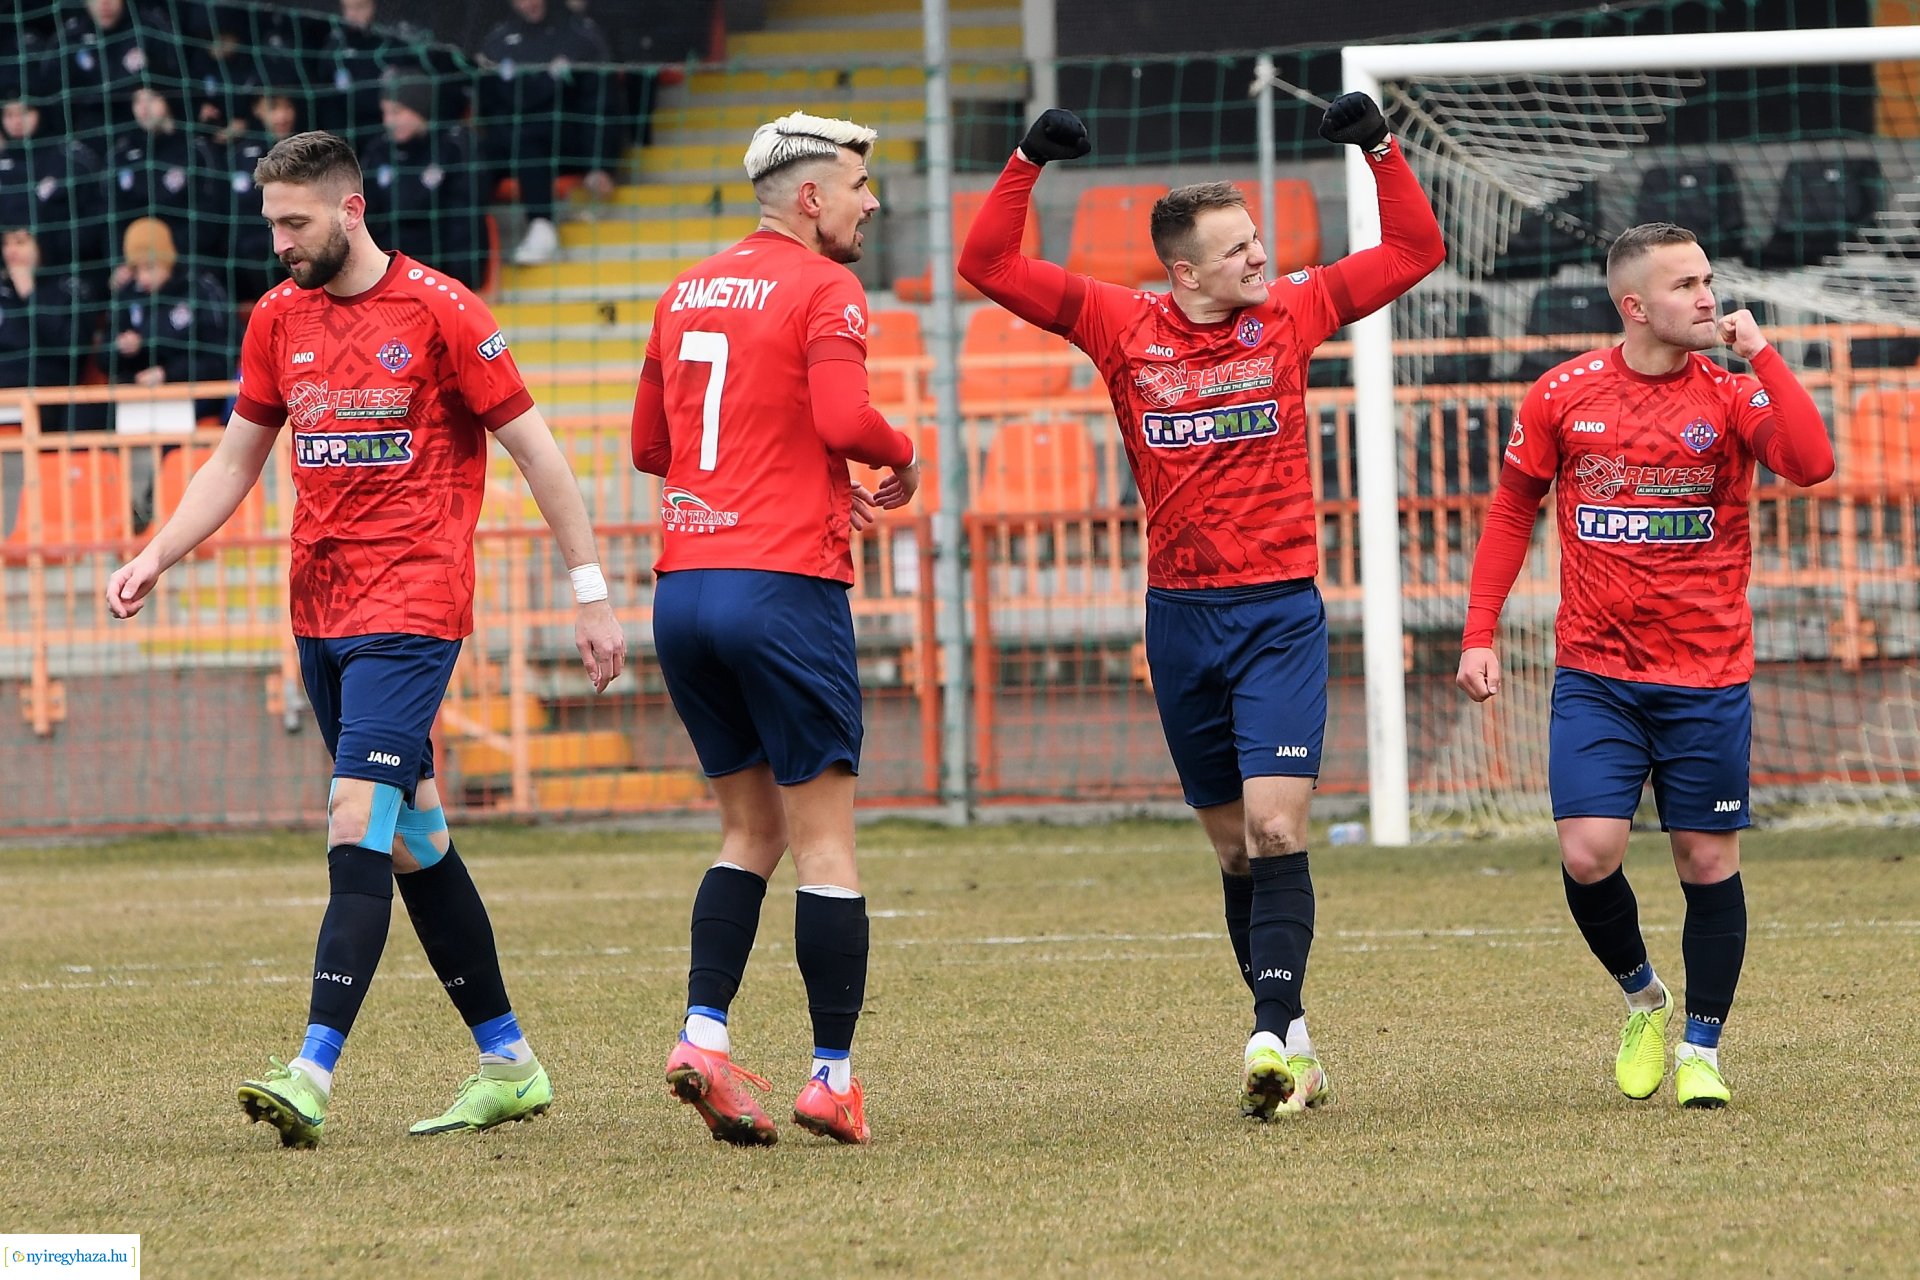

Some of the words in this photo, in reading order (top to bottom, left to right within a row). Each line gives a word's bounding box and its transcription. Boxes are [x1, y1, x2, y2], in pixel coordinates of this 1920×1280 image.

[670, 276, 778, 312] ZAMOSTNY
[1145, 343, 1174, 358] JAKO
[1187, 356, 1274, 390] REVESZ
[327, 387, 413, 410] REVESZ
[678, 330, 729, 472] 7
[1572, 420, 1606, 433] JAKO
[1623, 464, 1717, 485] REVESZ
[688, 510, 739, 526] TRANS
[367, 751, 401, 767] JAKO
[1276, 745, 1308, 758] JAKO
[1714, 800, 1741, 812] JAKO
[315, 971, 353, 986] JAKO
[1257, 968, 1292, 981] JAKO
